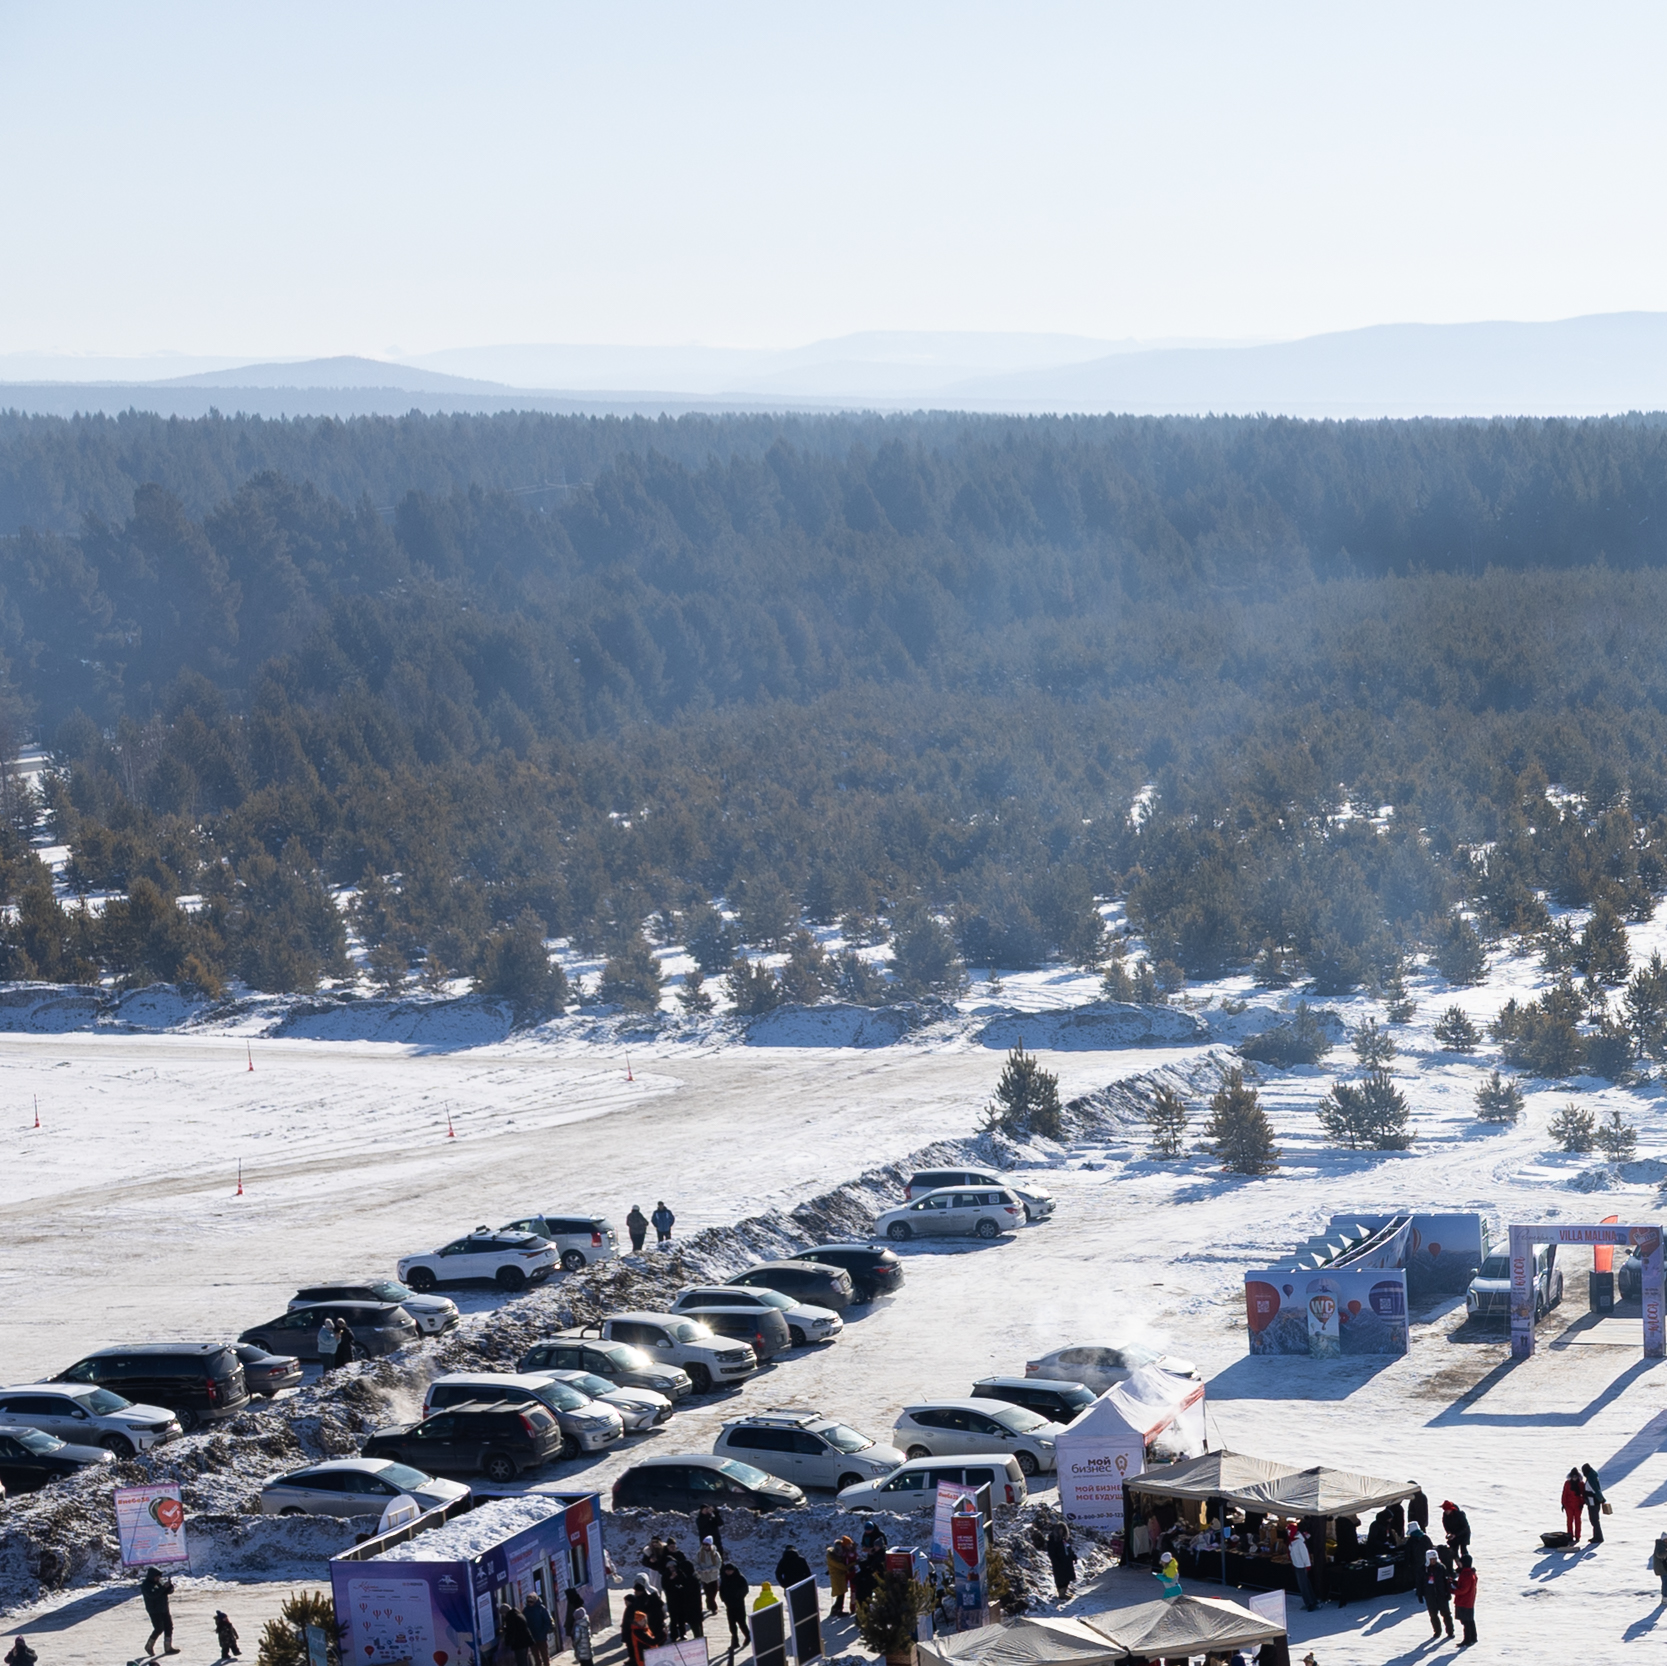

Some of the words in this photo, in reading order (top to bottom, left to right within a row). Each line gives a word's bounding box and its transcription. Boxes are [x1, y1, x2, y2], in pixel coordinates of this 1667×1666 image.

[1559, 1230, 1583, 1241] VILLA
[1584, 1230, 1618, 1242] MALINA
[1311, 1300, 1335, 1314] WC
[1071, 1463, 1112, 1474] бизнес
[1075, 1485, 1094, 1493] МОЙ
[1096, 1484, 1121, 1492] БИЗНЕ
